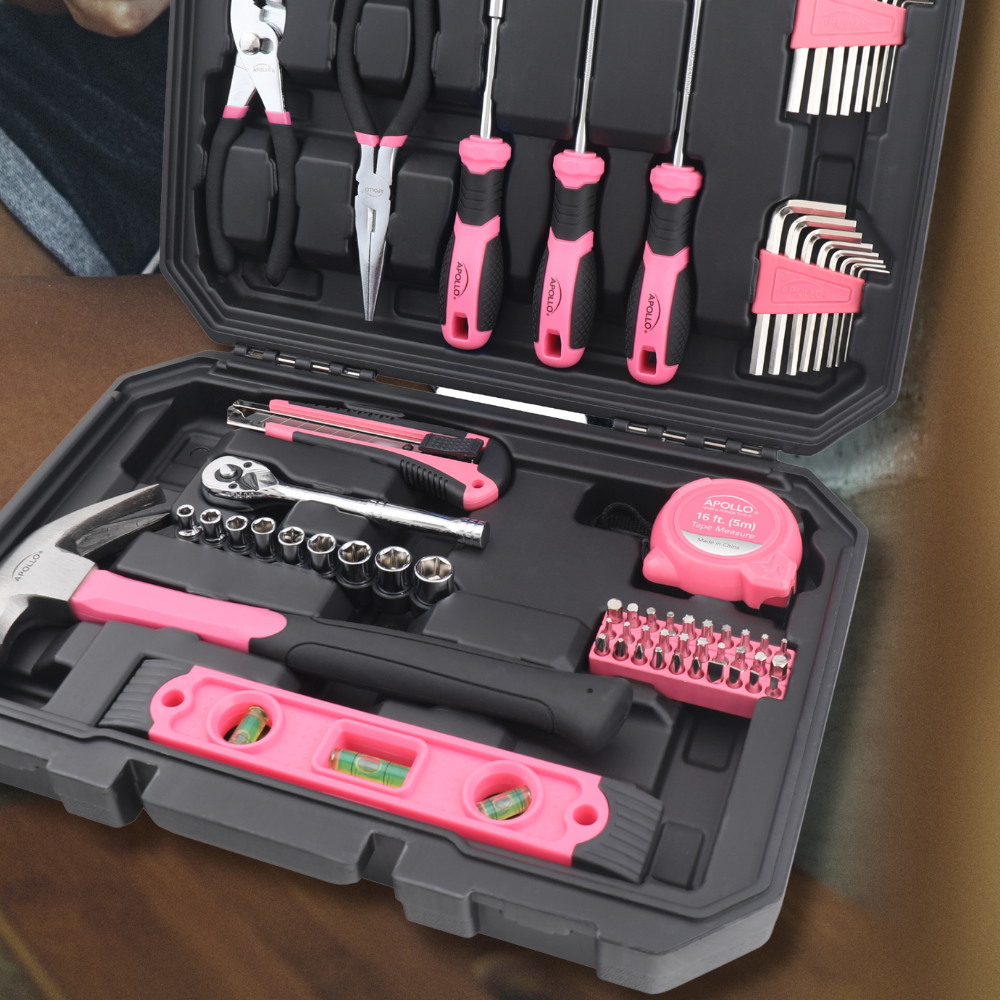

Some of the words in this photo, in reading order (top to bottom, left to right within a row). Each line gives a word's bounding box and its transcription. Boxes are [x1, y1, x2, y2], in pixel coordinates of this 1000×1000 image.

[820, 17, 865, 30] APOLLO
[453, 261, 463, 297] APOLLO
[546, 277, 557, 314] APOLLO
[781, 285, 824, 299] APOLLO
[644, 293, 655, 330] APOLLO
[703, 499, 754, 513] APOLLO
[692, 520, 713, 531] Tape
[714, 525, 756, 539] Measure
[697, 512, 710, 521] 16
[712, 514, 725, 525] ft.
[728, 517, 756, 532] (5m)
[697, 537, 715, 545] Made
[722, 542, 740, 550] China
[14, 553, 41, 582] APOLLO
